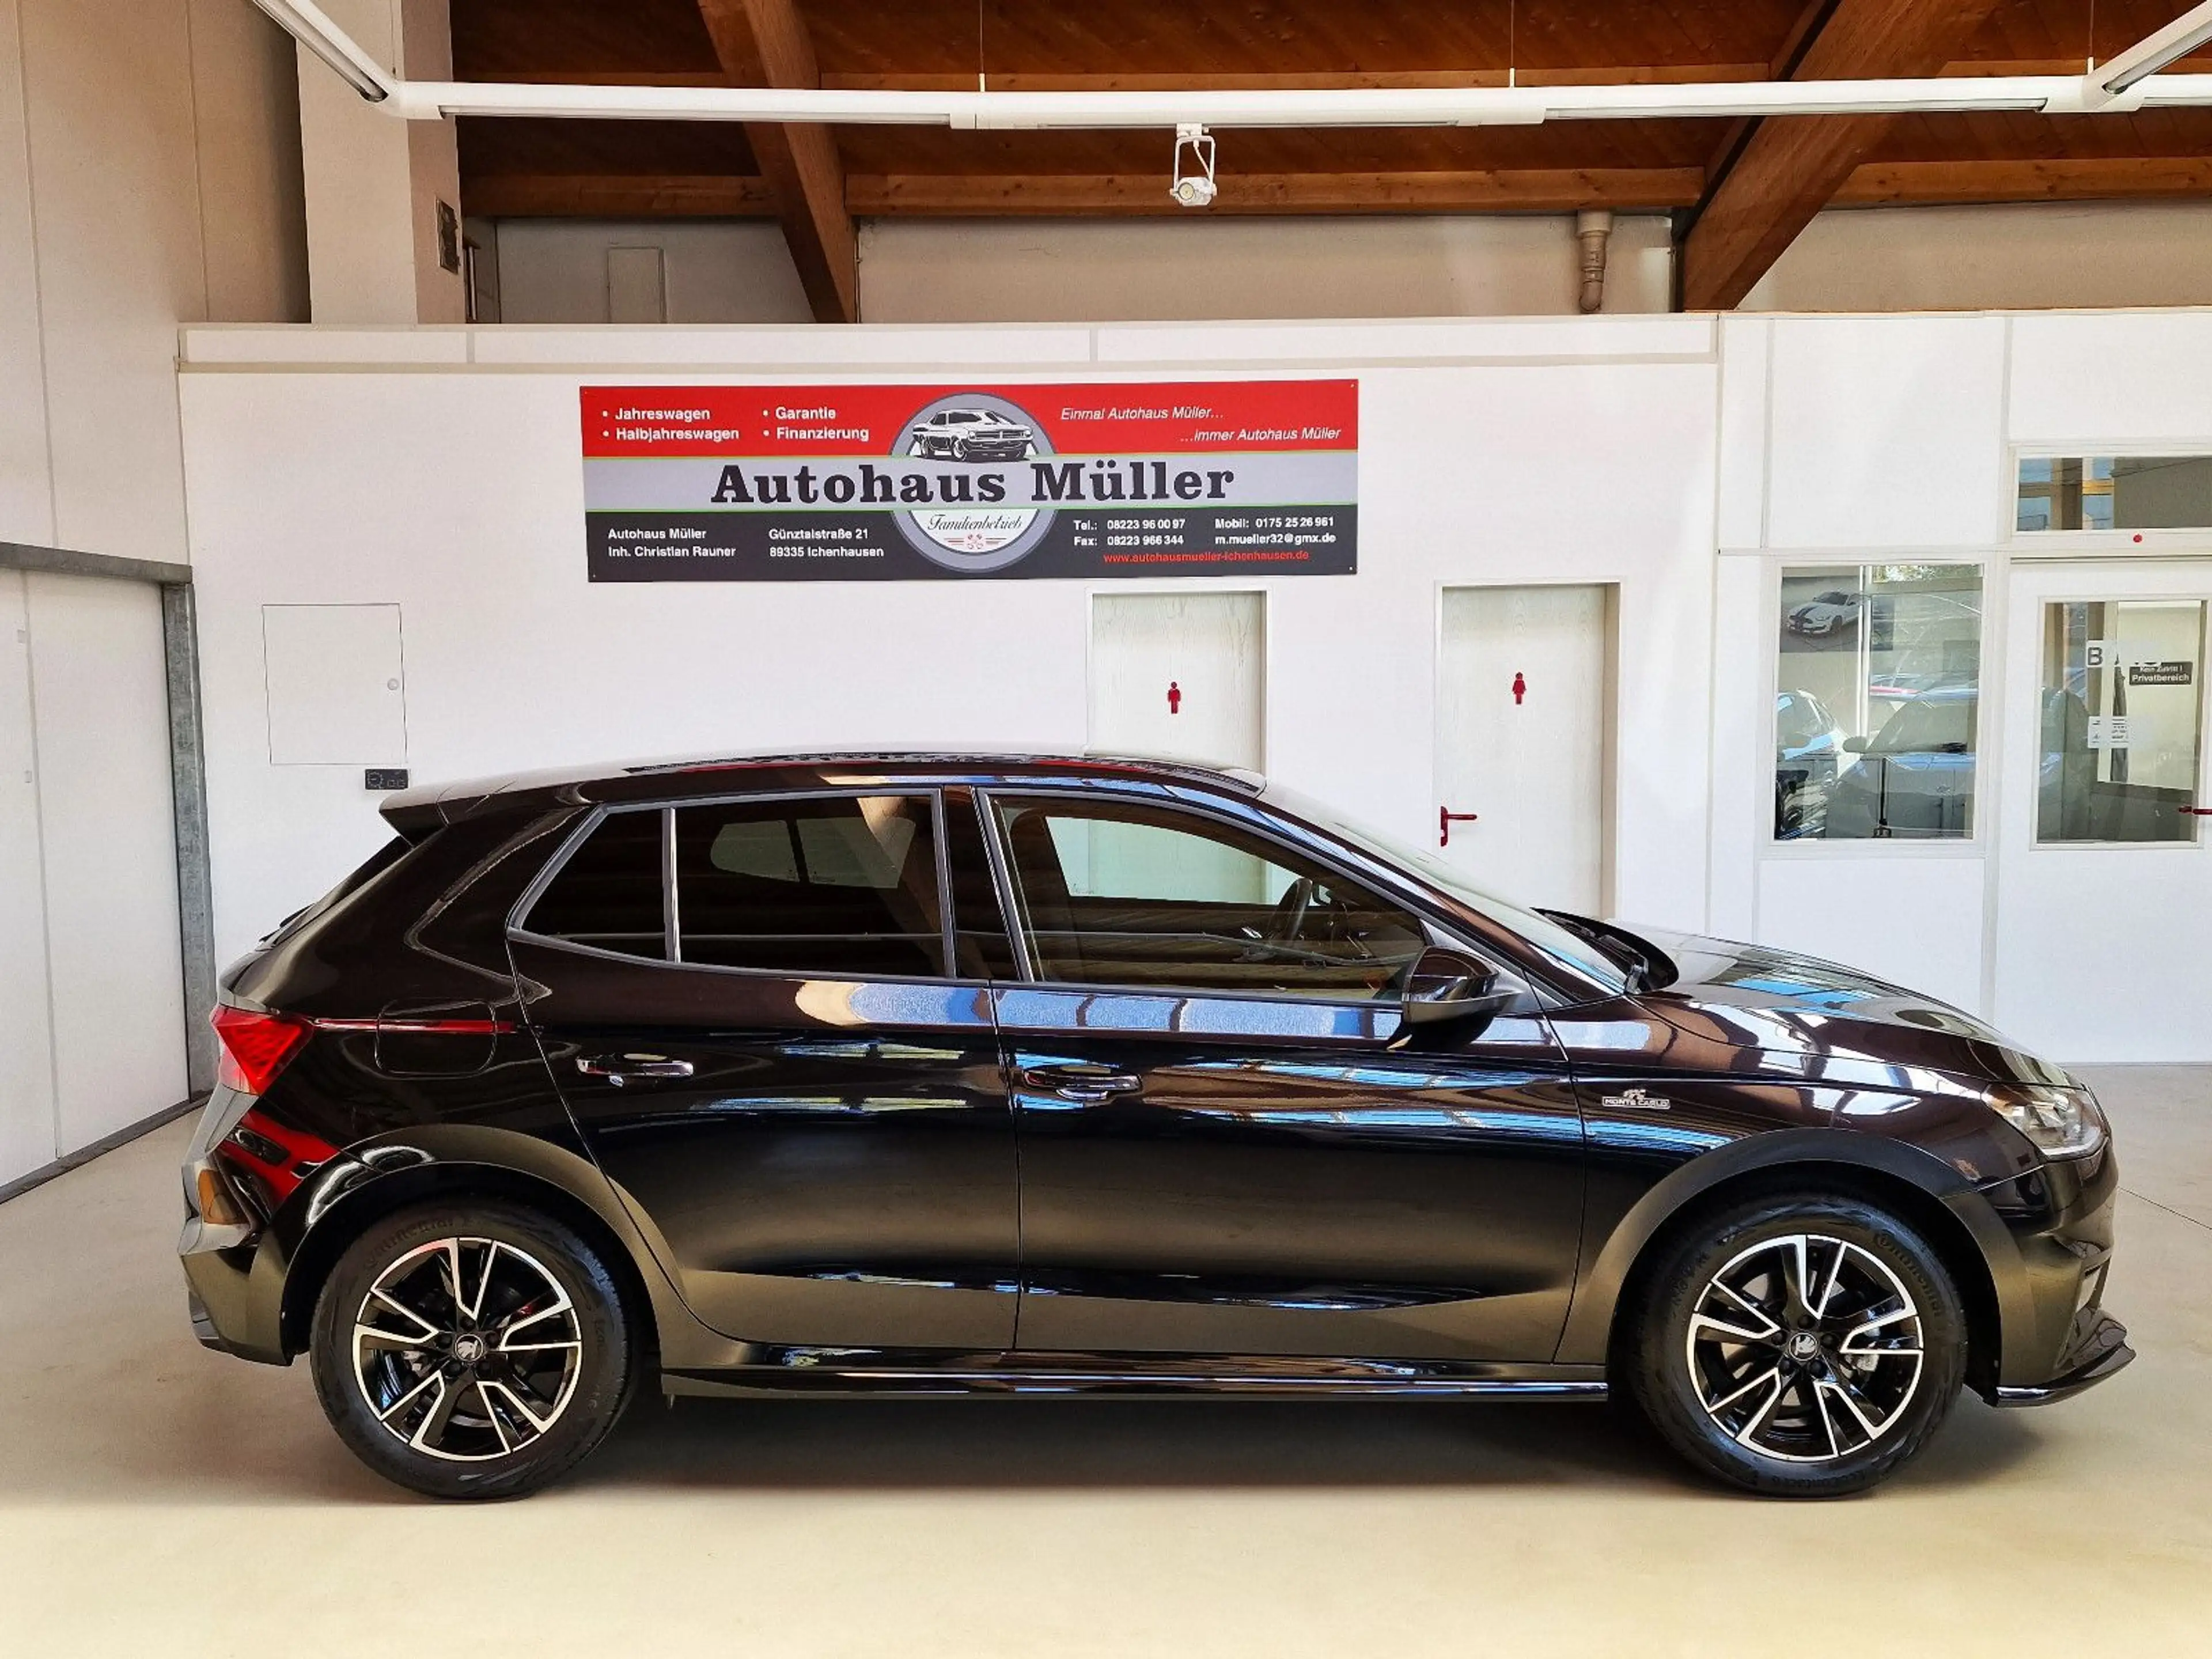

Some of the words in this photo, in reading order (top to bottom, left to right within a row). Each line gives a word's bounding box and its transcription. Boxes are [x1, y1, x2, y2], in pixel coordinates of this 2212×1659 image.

[615, 408, 710, 422] Jahreswagen
[775, 406, 836, 419] Garantie
[1060, 407, 1104, 420] Einmal
[1108, 407, 1168, 419] Autohaus
[616, 427, 739, 443] Halbjahreswagen
[777, 426, 869, 442] Finanzierung
[1237, 429, 1297, 441] Autohaus
[1302, 427, 1341, 440] Müller
[711, 464, 1006, 503] Autohaus
[1030, 459, 1234, 501] Müller
[927, 514, 1022, 530] Familienbetrieb
[1073, 520, 1097, 530] Tel.:
[1107, 520, 1139, 529] 08223
[1215, 518, 1249, 529] Mobil:
[1255, 518, 1282, 528] 0175
[608, 528, 666, 539] Autohaus
[669, 528, 707, 539] Müller
[768, 528, 852, 539] Günztalstraße
[855, 528, 868, 539] 21
[1215, 532, 1336, 546] m.mueller32@gmx.de
[1074, 536, 1097, 546] Fax:
[608, 546, 631, 557] Inh.
[634, 546, 690, 557] Christian
[692, 546, 736, 557] Rauner
[770, 547, 804, 557] 89335
[808, 546, 884, 557] Ichenhausen
[1103, 550, 1309, 563] www.autohausmueller-ichenhausen.de
[2131, 673, 2190, 683] Privatbereich
[1605, 1098, 1636, 1106] MONTE
[1638, 1099, 1668, 1108] CARLO
